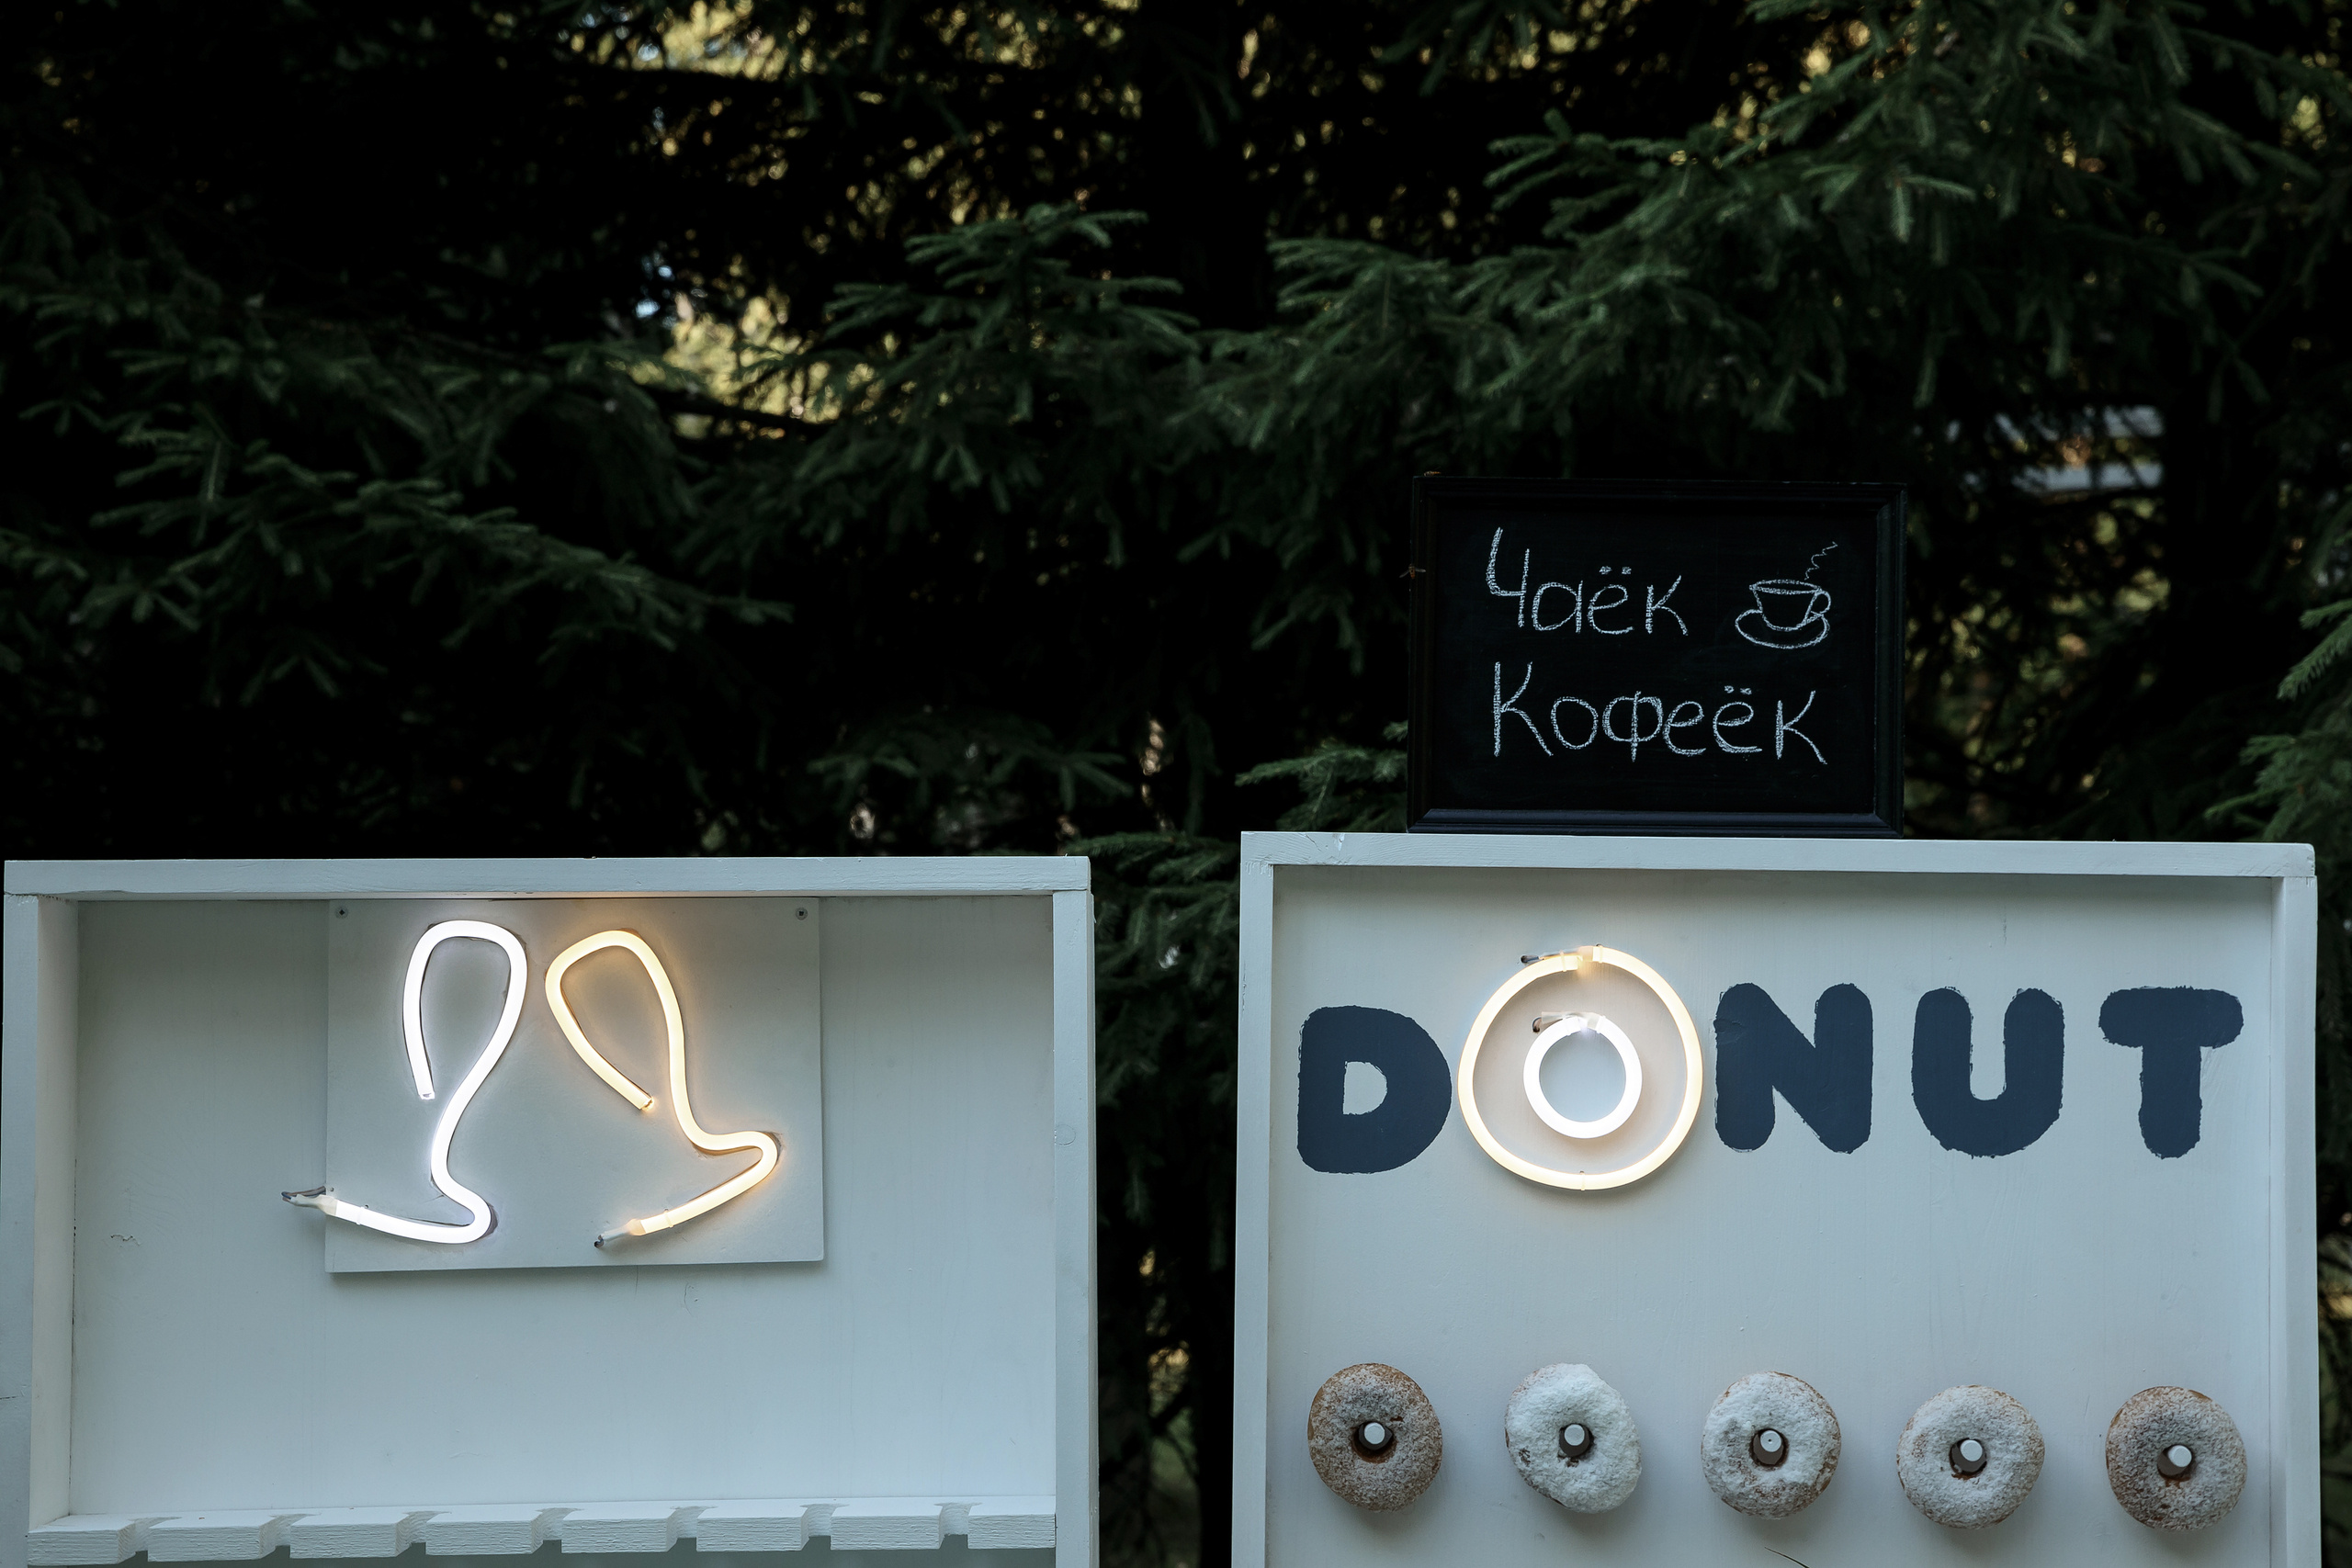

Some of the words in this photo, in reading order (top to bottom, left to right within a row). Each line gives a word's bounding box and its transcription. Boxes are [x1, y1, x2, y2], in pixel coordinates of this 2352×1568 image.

[1486, 526, 1688, 635] Чаёк
[1492, 661, 1828, 764] Кофеёк
[1296, 945, 2245, 1191] DONUT
